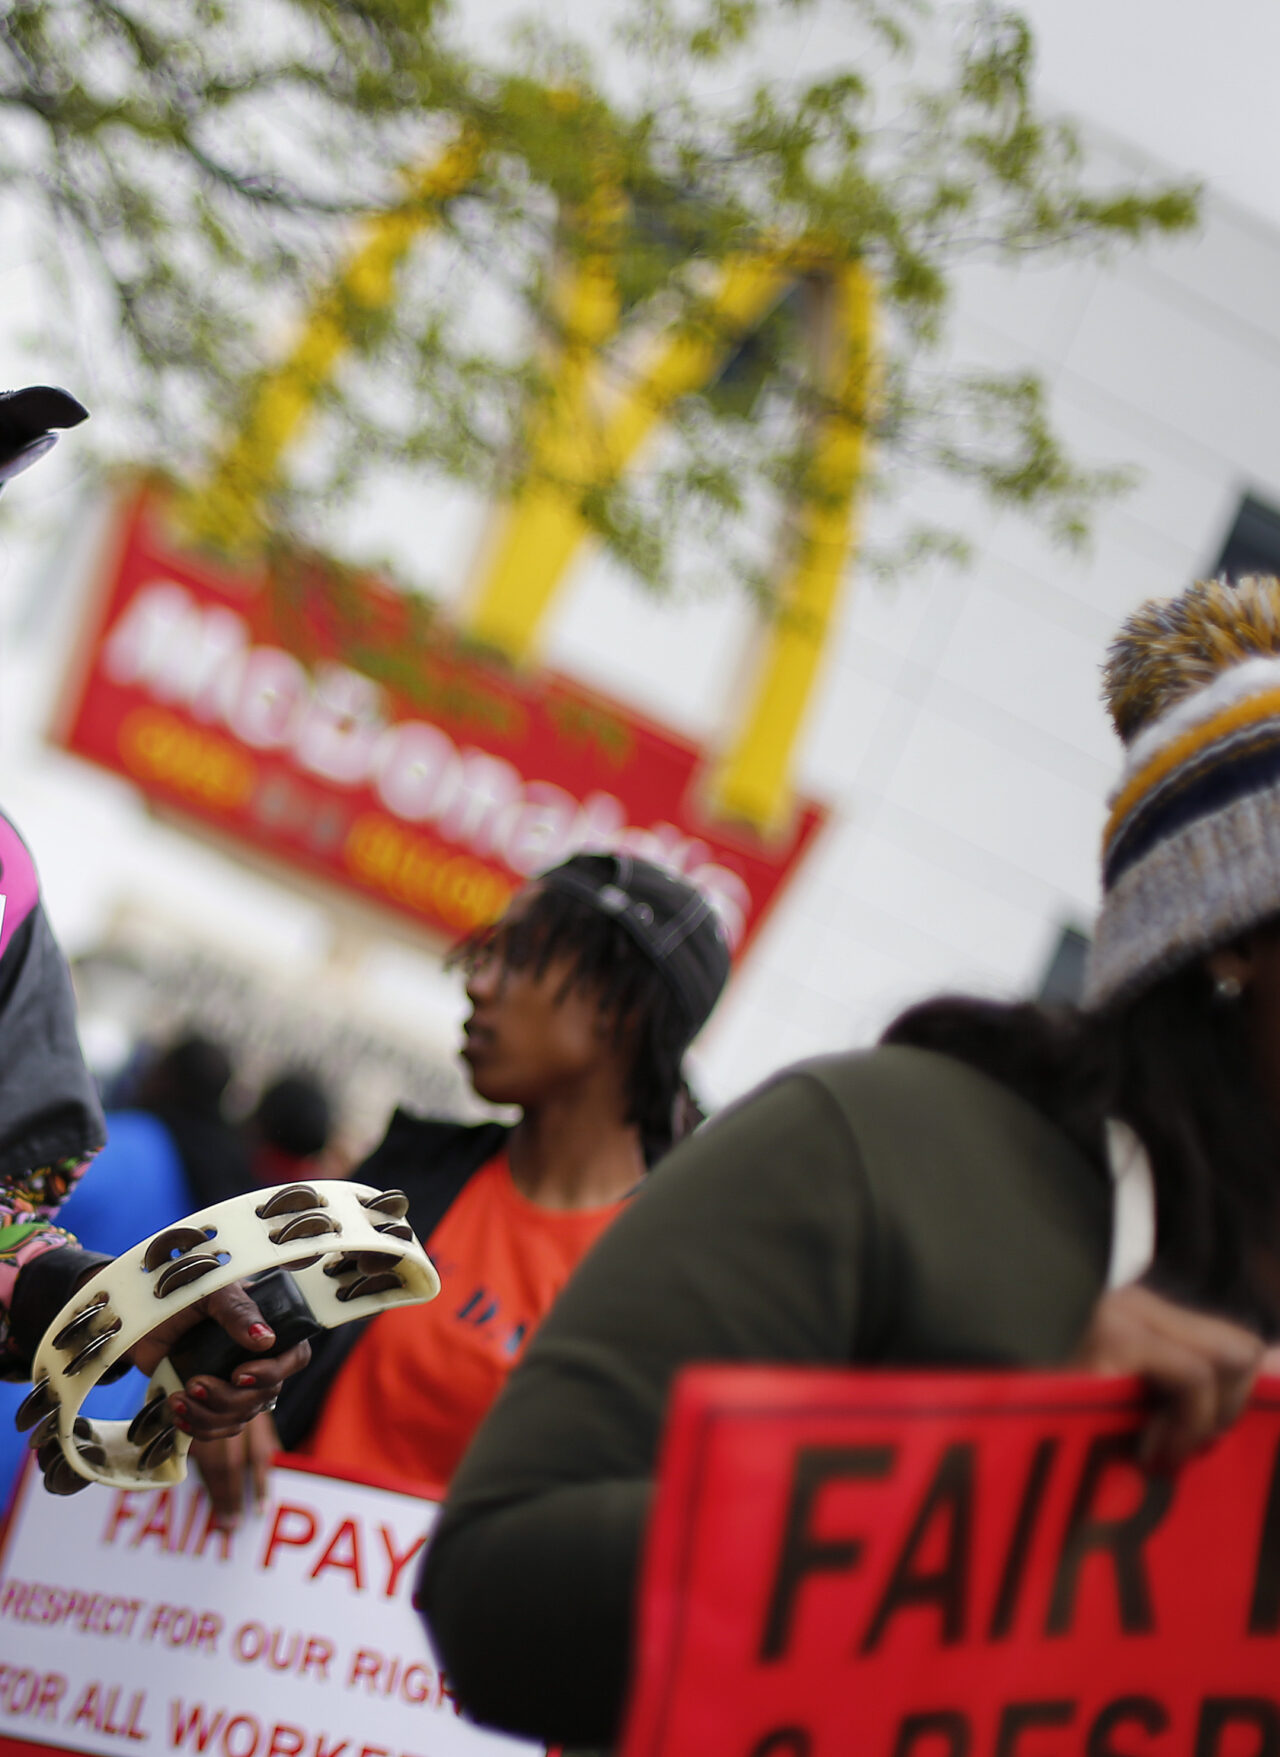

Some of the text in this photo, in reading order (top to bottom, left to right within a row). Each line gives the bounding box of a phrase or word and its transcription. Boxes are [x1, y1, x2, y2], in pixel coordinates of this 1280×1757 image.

[260, 1503, 427, 1598] PAY
[756, 1431, 1183, 1664] FAIR
[0, 1579, 142, 1637] RESPECT
[144, 1603, 223, 1653] FOR
[233, 1621, 336, 1681] OUR
[69, 1680, 148, 1742] ALL
